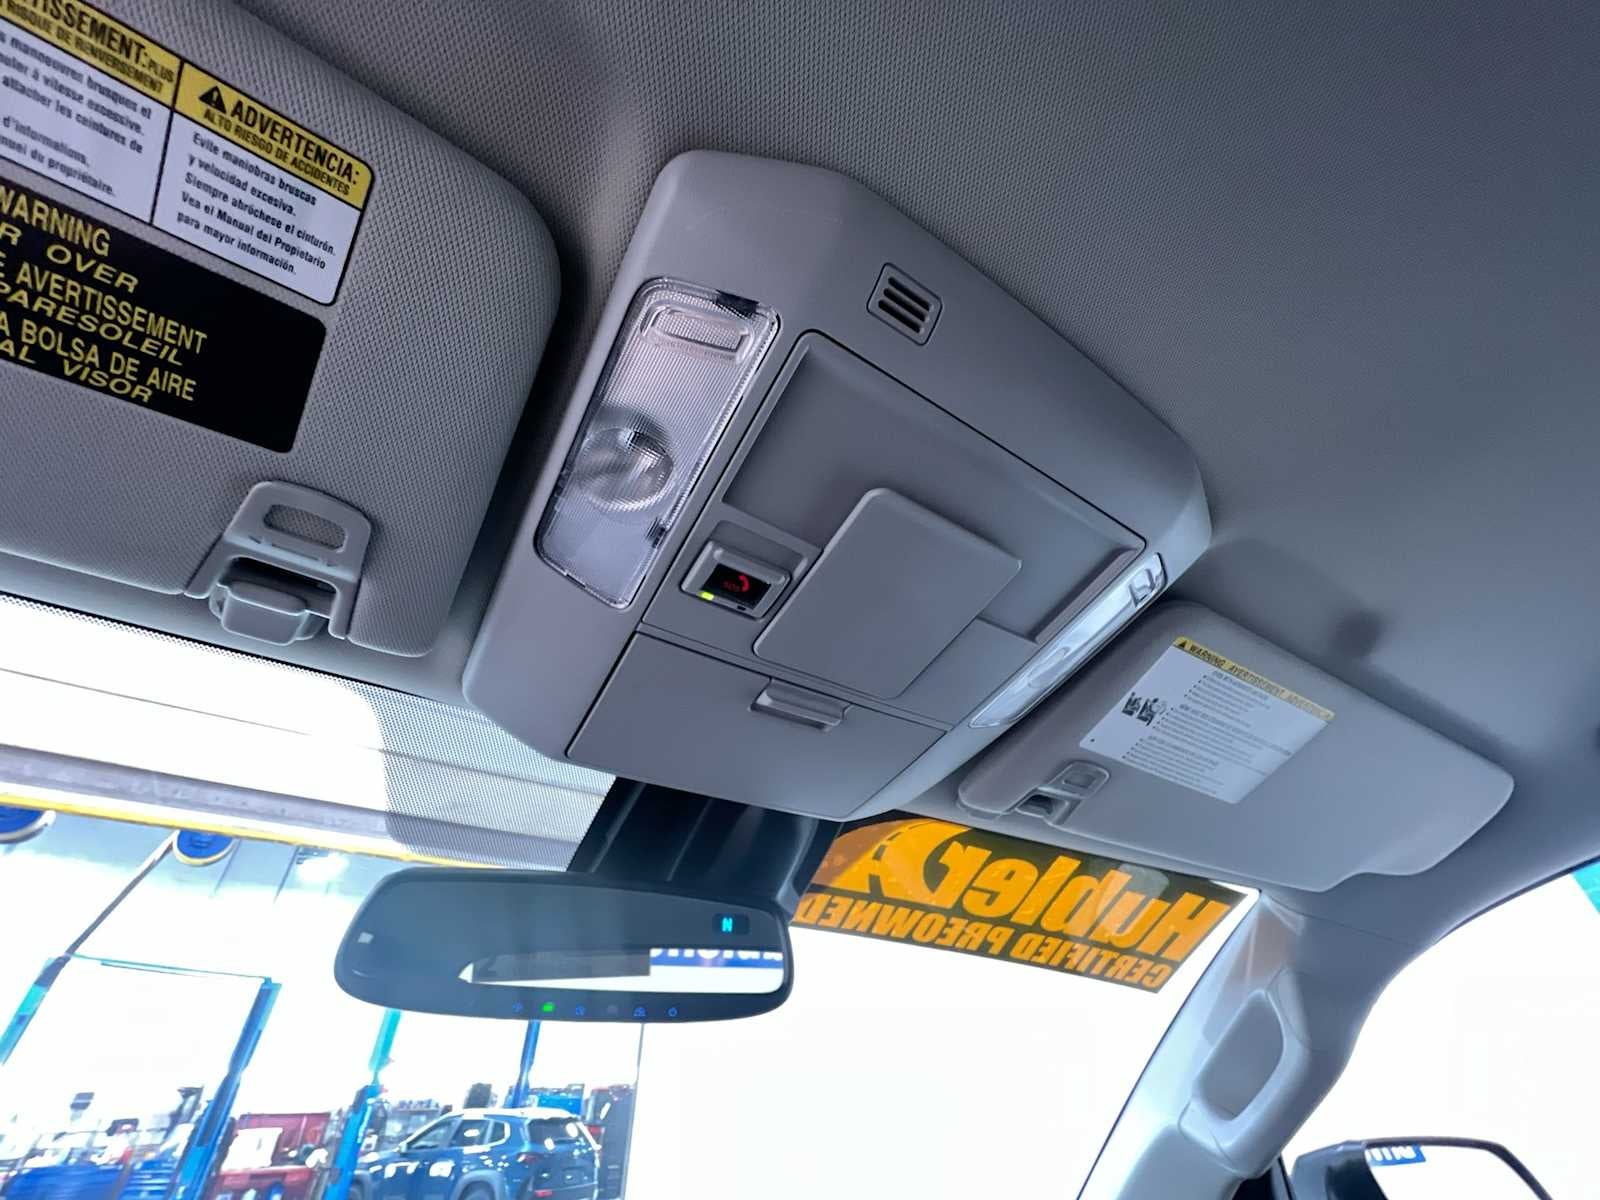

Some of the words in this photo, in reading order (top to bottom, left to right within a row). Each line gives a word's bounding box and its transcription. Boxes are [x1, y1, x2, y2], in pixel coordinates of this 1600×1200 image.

[56, 25, 73, 44] DE
[31, 148, 45, 164] du
[55, 99, 72, 118] les
[129, 139, 143, 154] de
[204, 108, 232, 131] ALTO
[234, 122, 273, 154] RIESGO
[275, 147, 288, 163] DE
[291, 156, 350, 196] ACCIDENTES
[231, 99, 360, 185] ADVERTENCIA:
[188, 154, 196, 168] y
[199, 158, 248, 191] velocidad
[250, 186, 297, 217] excesiva.
[193, 131, 219, 155] Evite
[222, 149, 275, 185] maniobras
[278, 177, 317, 206] bruscas
[176, 211, 200, 230] para
[203, 223, 236, 246] mayor
[181, 190, 201, 209] Vea
[203, 203, 214, 216] el
[216, 208, 255, 236] Manual
[256, 228, 272, 243] del
[274, 236, 326, 270] Propietario
[185, 171, 229, 203] Siempre
[231, 197, 282, 229] abróchese
[284, 223, 295, 235] el
[46, 244, 139, 293] OVER
[16, 260, 208, 355] AVERTISSEMENT
[21, 318, 100, 368] BOLSA
[110, 351, 140, 381] DE
[147, 367, 197, 401] AIRE
[63, 359, 153, 403] VISOR
[722, 917, 733, 932] N
